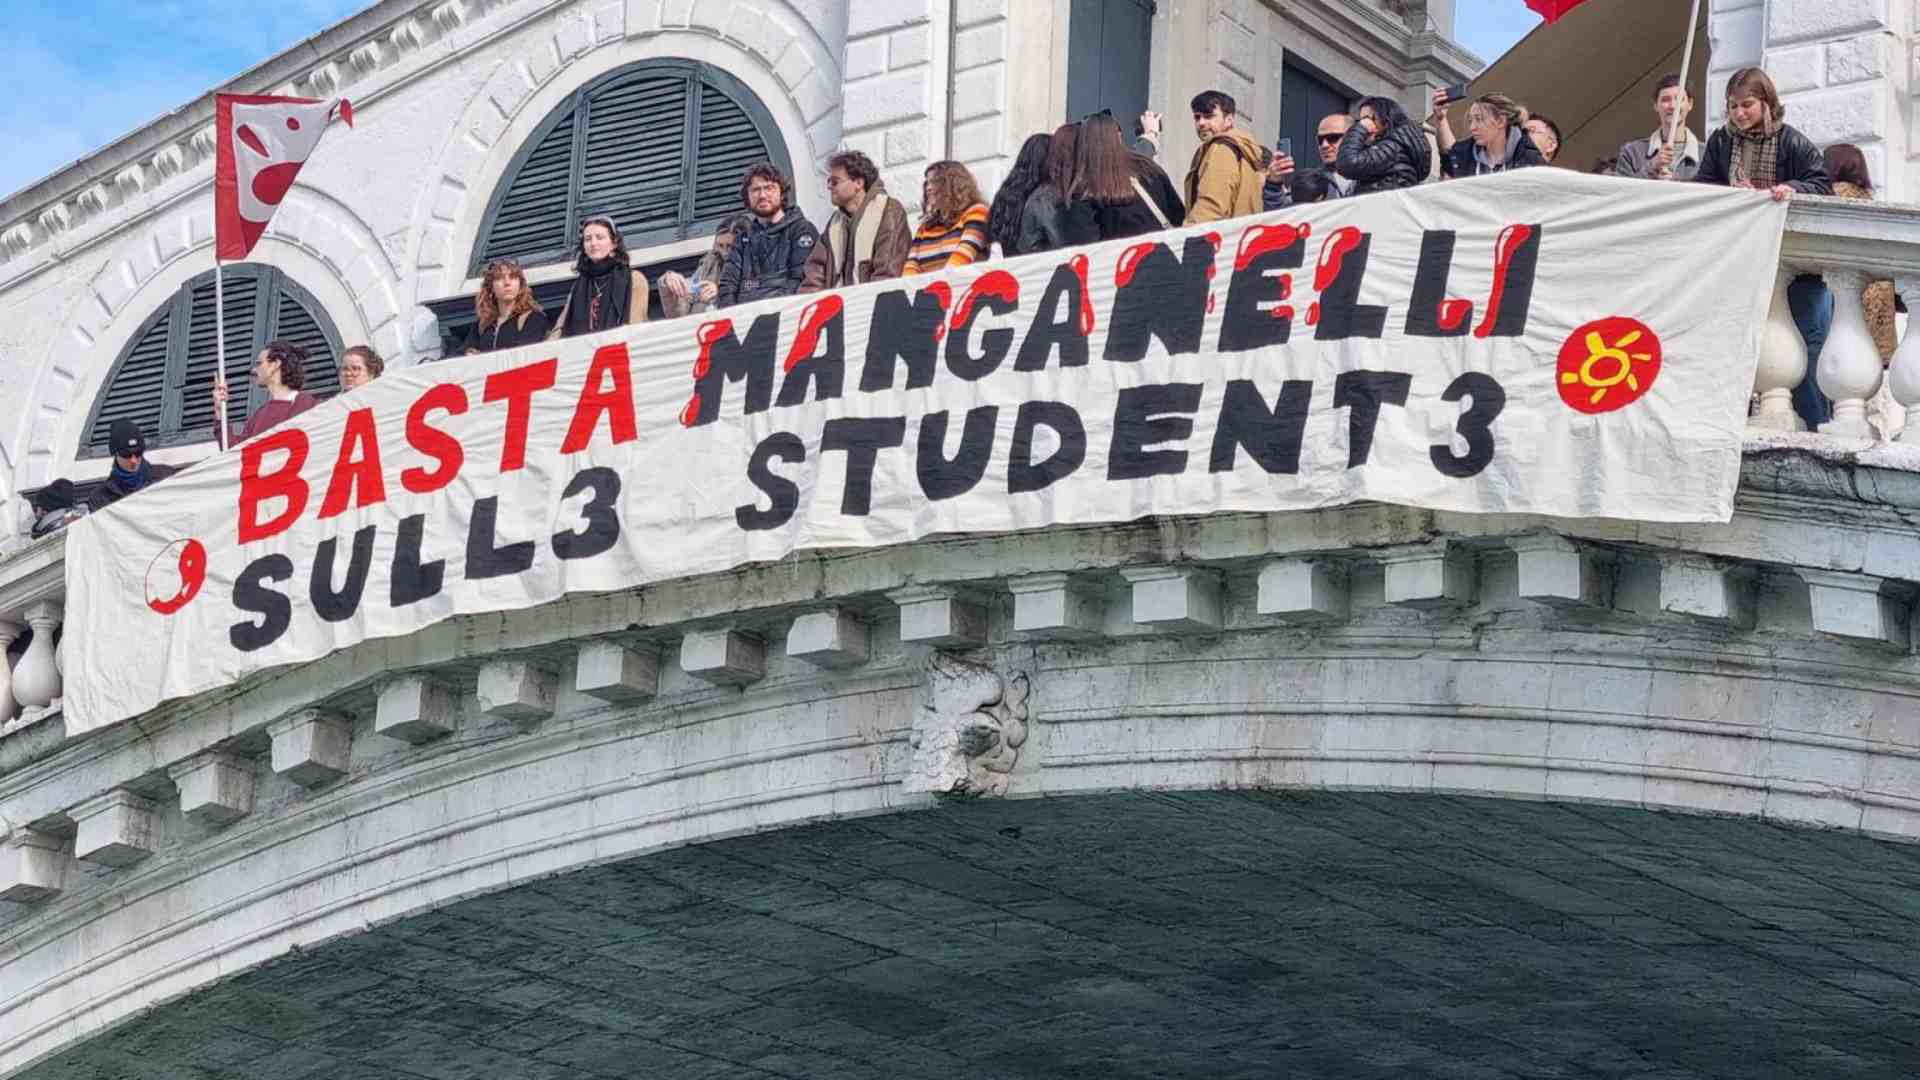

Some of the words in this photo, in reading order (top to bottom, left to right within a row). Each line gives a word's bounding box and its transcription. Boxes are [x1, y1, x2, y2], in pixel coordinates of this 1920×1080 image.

[229, 466, 621, 652] SULL3
[735, 371, 1506, 530] STUDENT3
[238, 342, 637, 544] BASTA
[679, 222, 1542, 428] MANGANELLI
